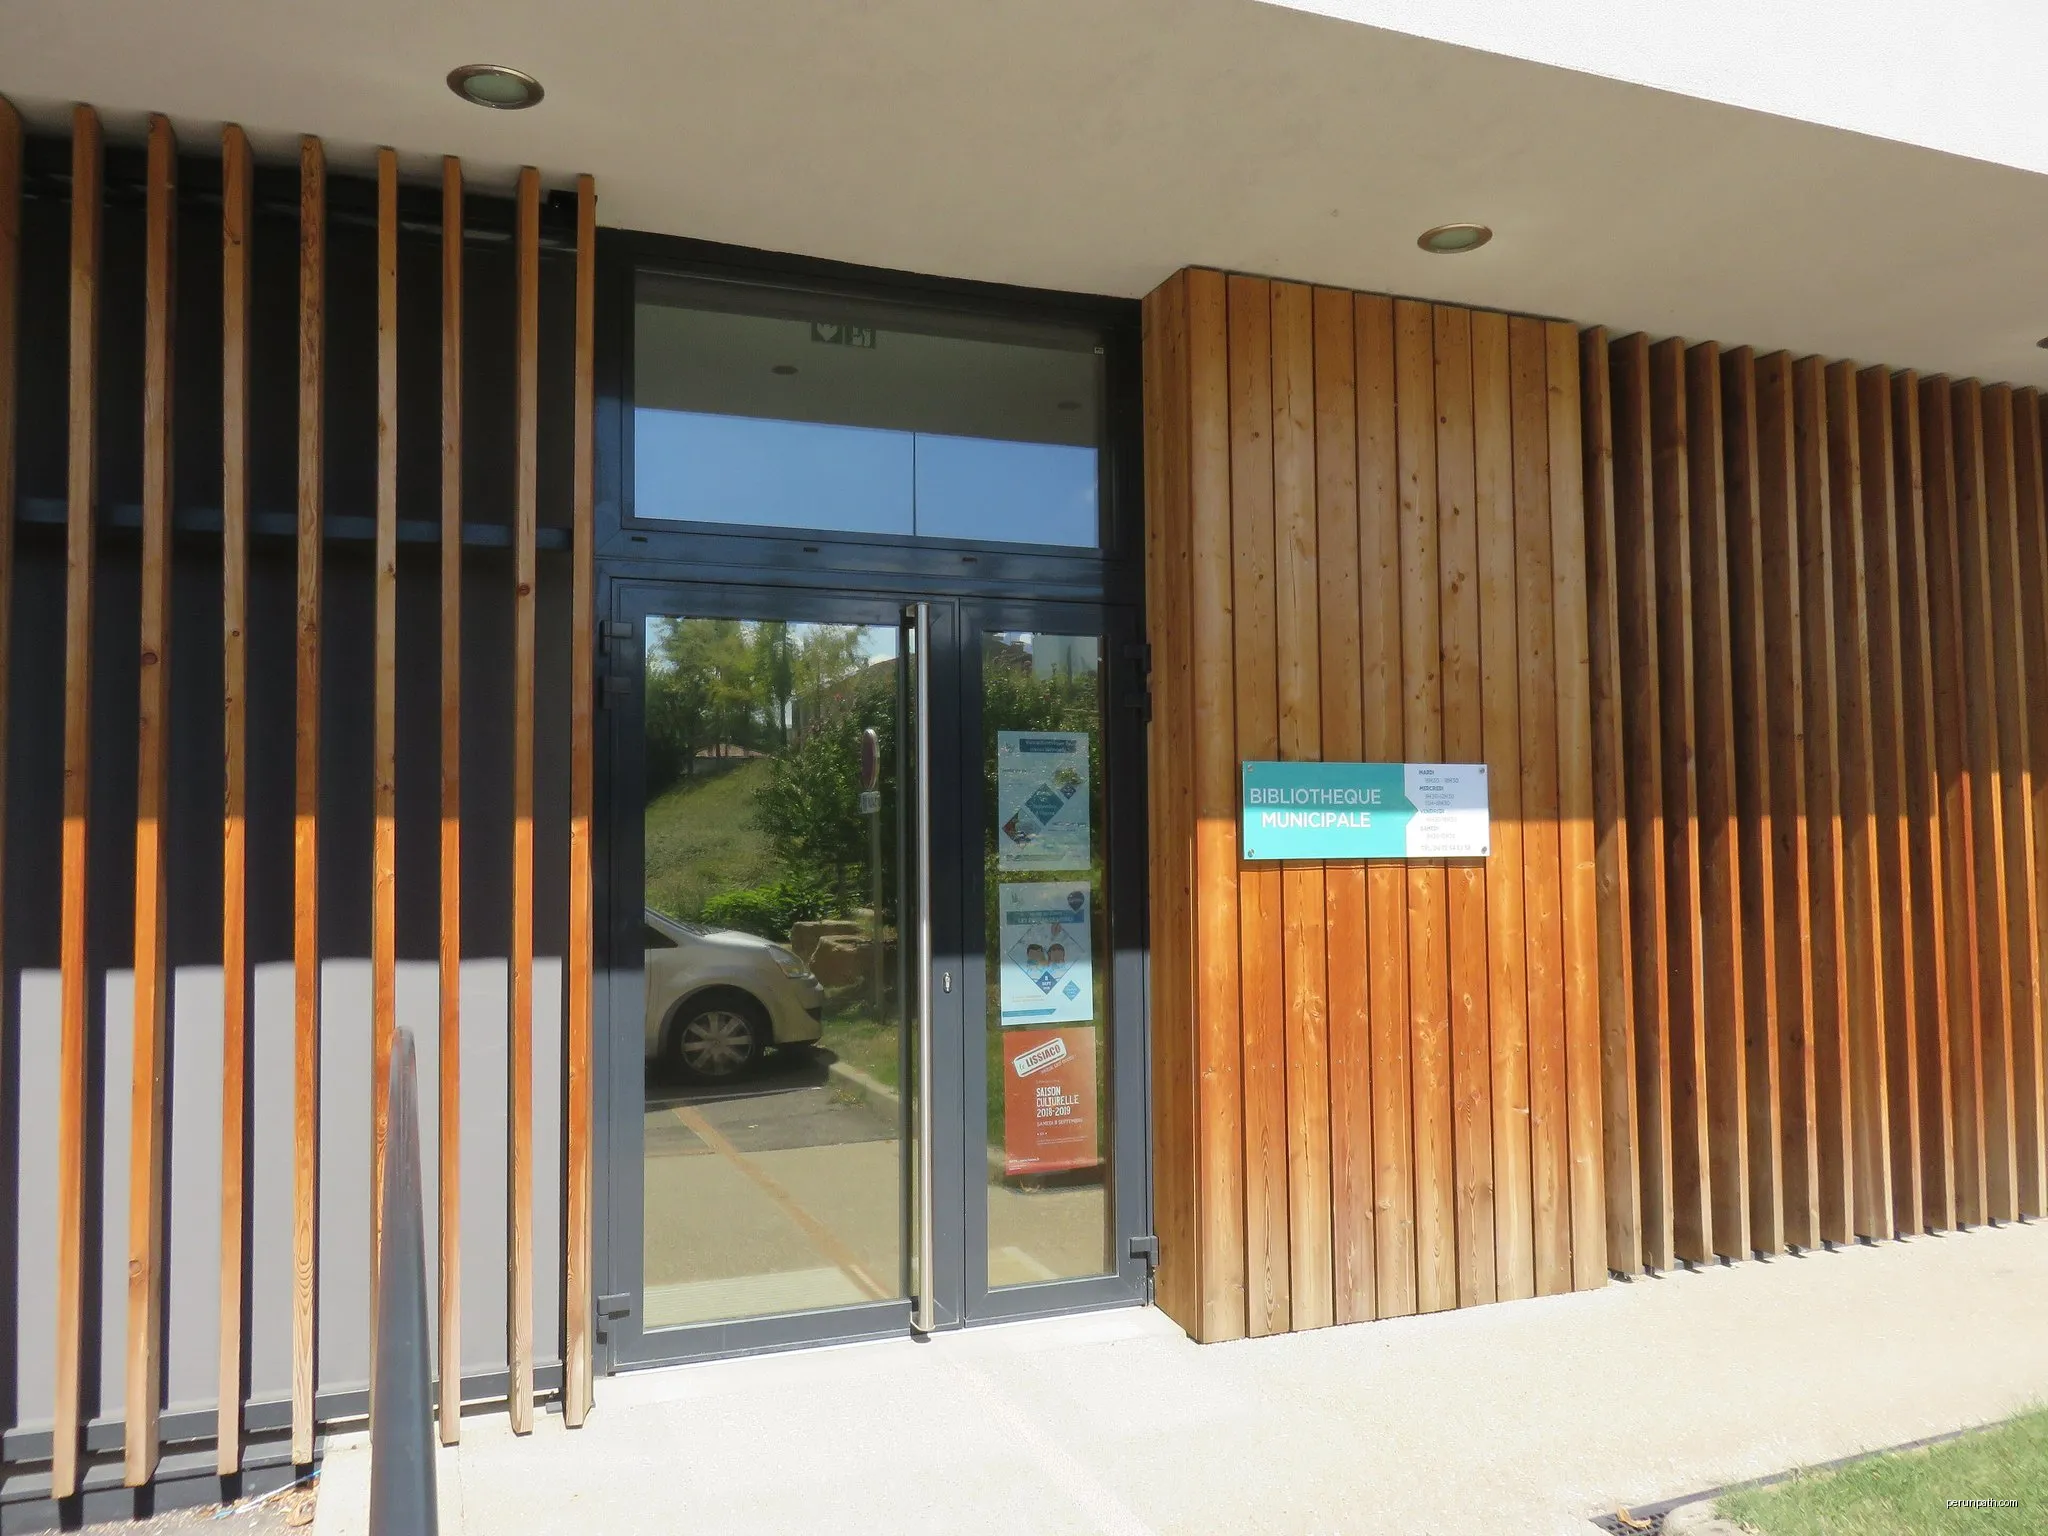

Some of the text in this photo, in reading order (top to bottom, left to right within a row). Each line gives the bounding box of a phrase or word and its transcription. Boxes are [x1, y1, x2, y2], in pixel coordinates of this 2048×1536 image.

[1249, 788, 1382, 806] BIBLIOTHEQUE
[1260, 811, 1372, 829] MUNICIPALE
[1025, 1044, 1061, 1067] LISSIACO
[1036, 1086, 1061, 1097] SAISON
[1036, 1094, 1080, 1107] CULTURELLE
[1036, 1106, 1071, 1118] 2018-2019
